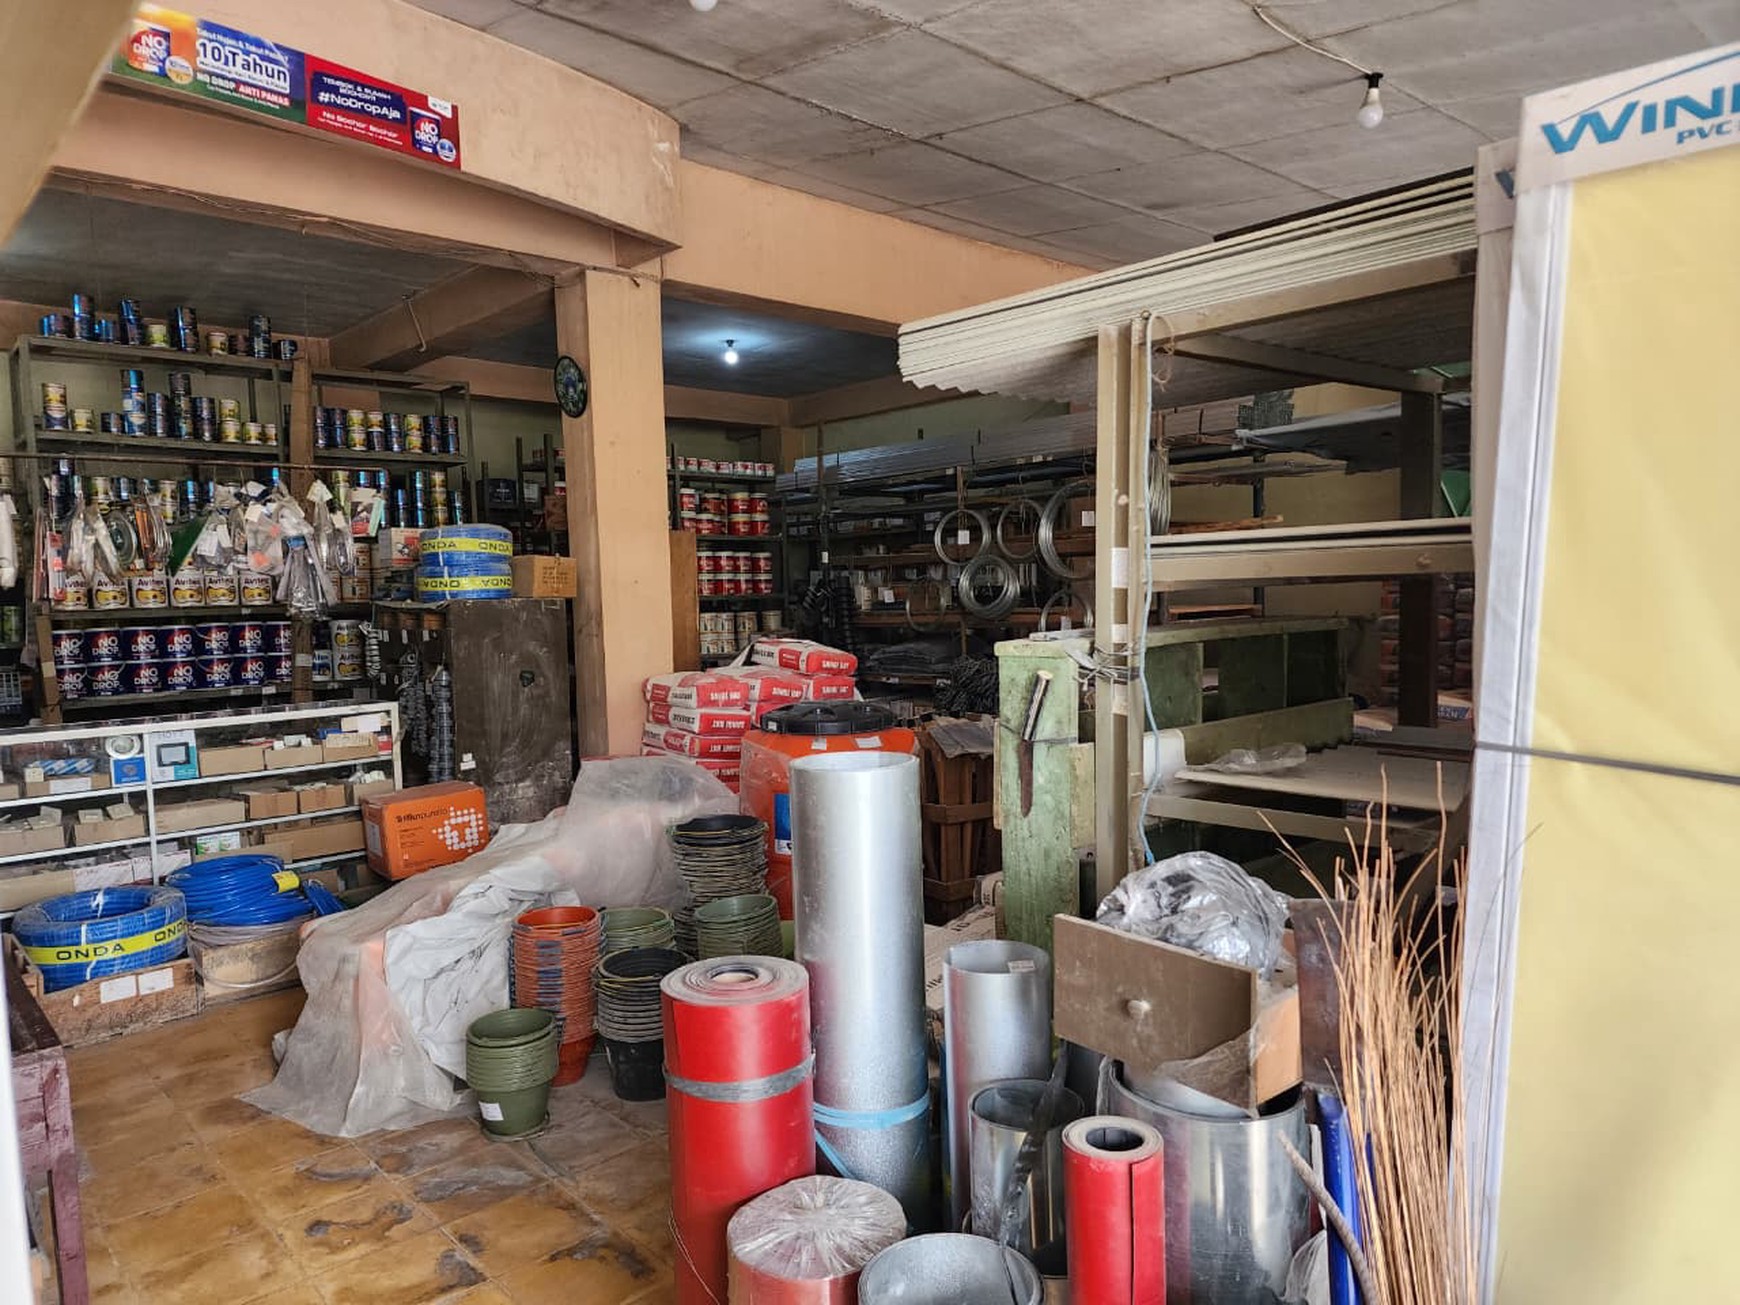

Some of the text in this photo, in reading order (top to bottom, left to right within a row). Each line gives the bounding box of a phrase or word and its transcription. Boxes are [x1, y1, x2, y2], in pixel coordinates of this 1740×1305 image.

[141, 34, 166, 50] NO
[133, 42, 167, 60] DROP
[199, 42, 222, 62] 10
[227, 50, 287, 84] Tahun
[318, 91, 401, 119] #NoDropAja
[421, 121, 438, 136] NO
[1676, 120, 1732, 144] PVC
[415, 130, 439, 144] DROP
[422, 541, 512, 553] ONDA ONDA
[138, 635, 155, 645] NO
[174, 634, 192, 643] NO
[212, 631, 229, 641] NO
[245, 630, 262, 640] NO
[61, 638, 80, 650] NO
[98, 636, 118, 647] NO
[205, 640, 229, 650] DROP
[239, 639, 262, 647] DROP
[54, 647, 80, 656] DROP
[131, 644, 156, 653] DROP
[167, 644, 192, 652] DROP
[174, 666, 193, 676] NO
[213, 664, 230, 673] NO
[248, 661, 265, 671] NO
[64, 672, 82, 682] NO
[98, 671, 119, 680] NO
[140, 667, 158, 677] NO
[206, 672, 231, 681] DROP
[241, 671, 265, 679] DROP
[93, 680, 119, 689] DROP
[134, 676, 159, 685] DROP
[168, 676, 193, 685] DROP
[56, 943, 126, 960] ONDA
